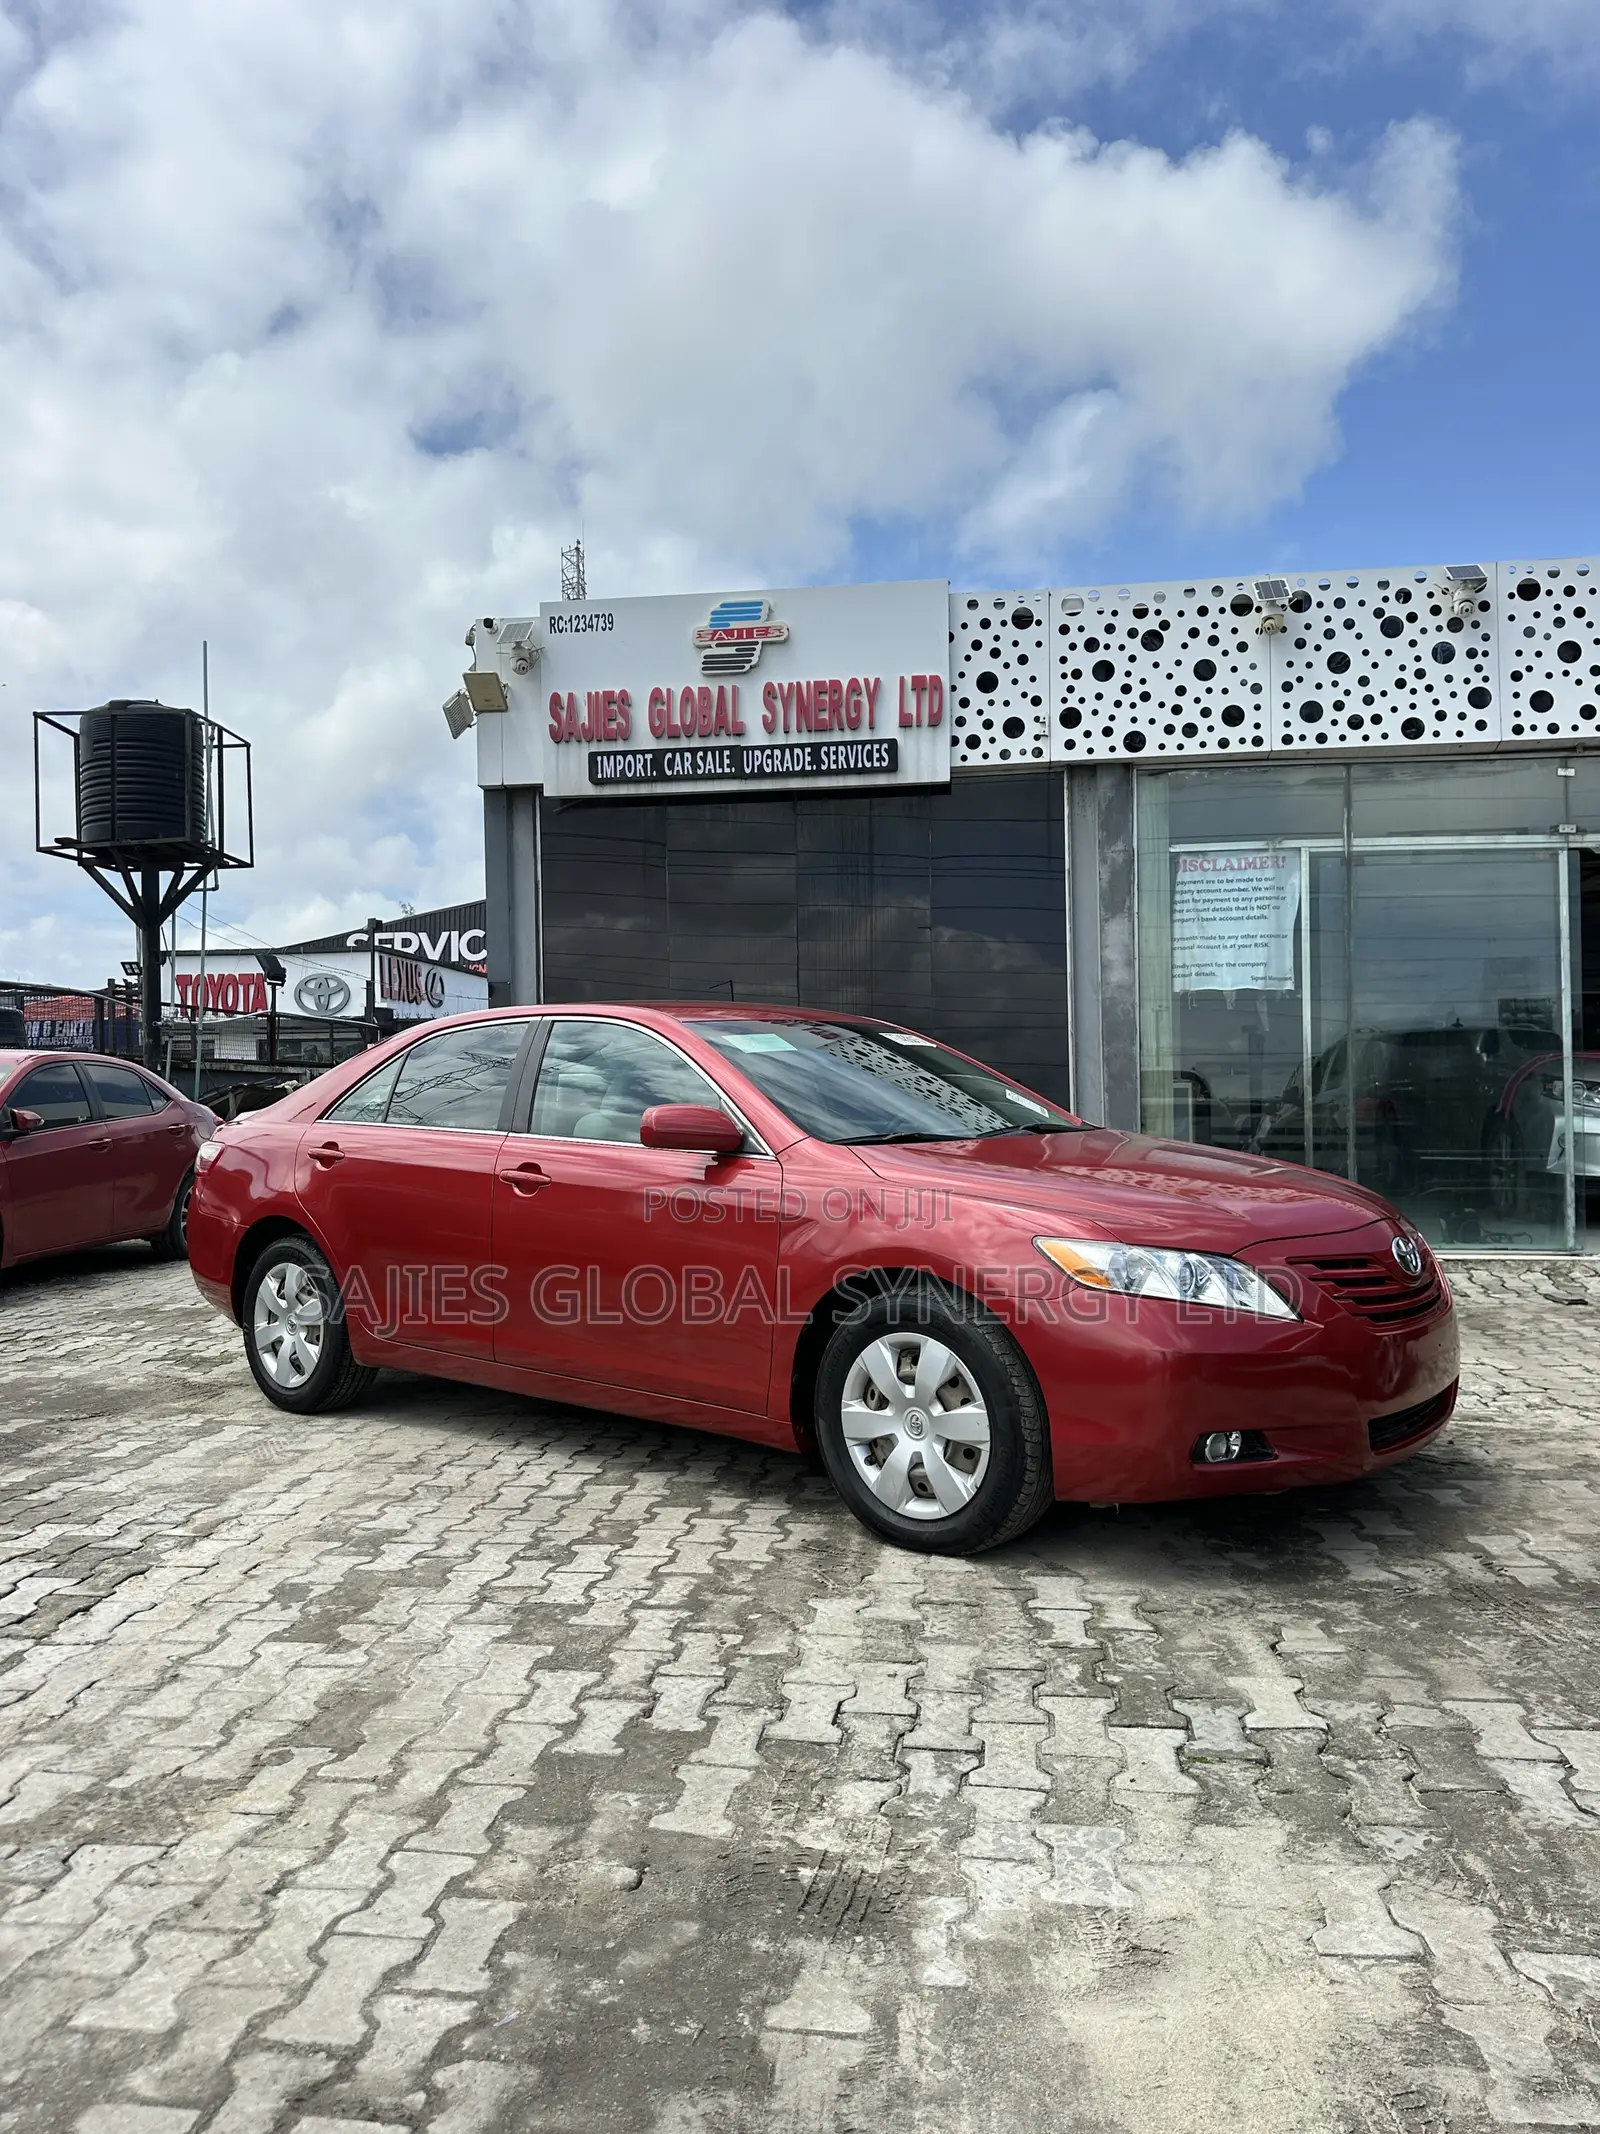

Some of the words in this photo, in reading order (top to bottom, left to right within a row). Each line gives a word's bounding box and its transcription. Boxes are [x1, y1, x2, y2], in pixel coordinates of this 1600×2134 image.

[549, 613, 614, 634] RC:1234739
[696, 625, 784, 641] SAJIES
[549, 688, 632, 743] SAJIES
[648, 684, 746, 738] GLOBAL
[762, 677, 881, 734] SYNERGY
[899, 674, 944, 727] LTD
[597, 754, 657, 779] IMPORT.
[664, 752, 693, 775] CAR
[697, 750, 736, 773] SALE.
[743, 747, 817, 773] UPGRADE.
[820, 743, 889, 769] SERVICES
[1176, 879, 1204, 887] payment
[1236, 876, 1254, 884] made
[1196, 886, 1222, 894] account
[1202, 896, 1231, 904] payment
[1240, 896, 1254, 904] any
[1234, 904, 1248, 912] that
[1218, 914, 1244, 922] account
[1240, 932, 1258, 940] other
[379, 954, 426, 1006] LEXUS
[176, 973, 268, 1017] TOYOTA
